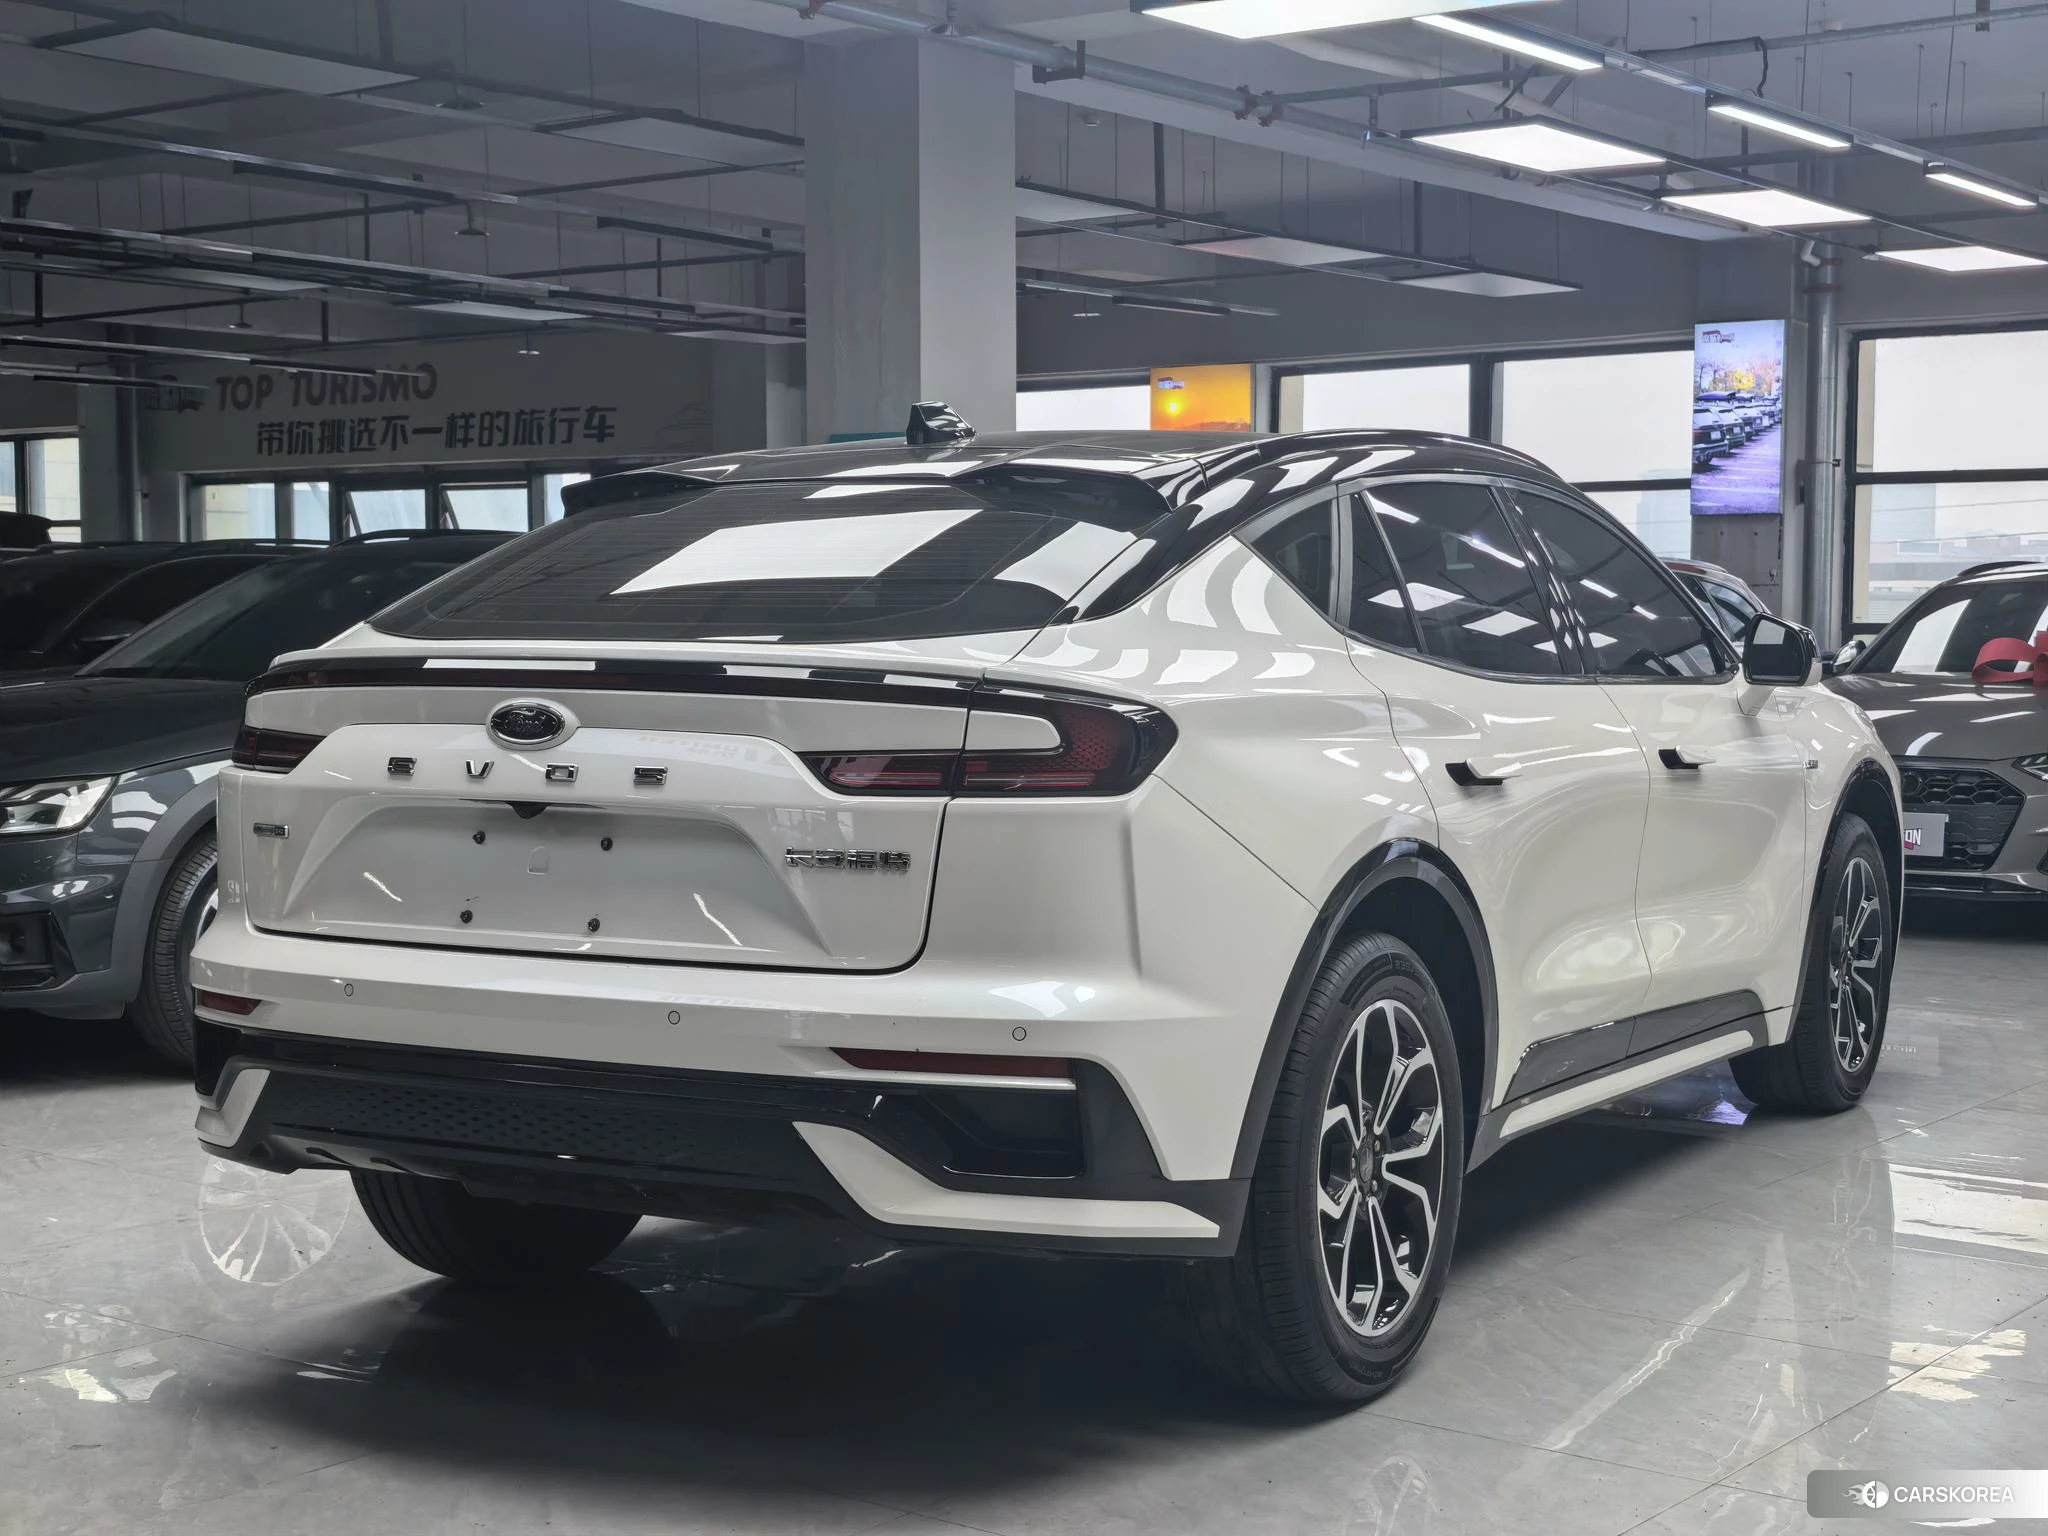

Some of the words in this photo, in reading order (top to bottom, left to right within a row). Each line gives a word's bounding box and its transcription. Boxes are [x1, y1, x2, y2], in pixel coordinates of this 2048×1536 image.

[215, 374, 273, 411] TOP
[287, 363, 438, 407] TURISMO
[256, 405, 617, 457] 带你挑选不一样的旅行车
[387, 756, 668, 786] EVOS
[1904, 828, 1922, 846] ON
[785, 847, 911, 871] 长安福特
